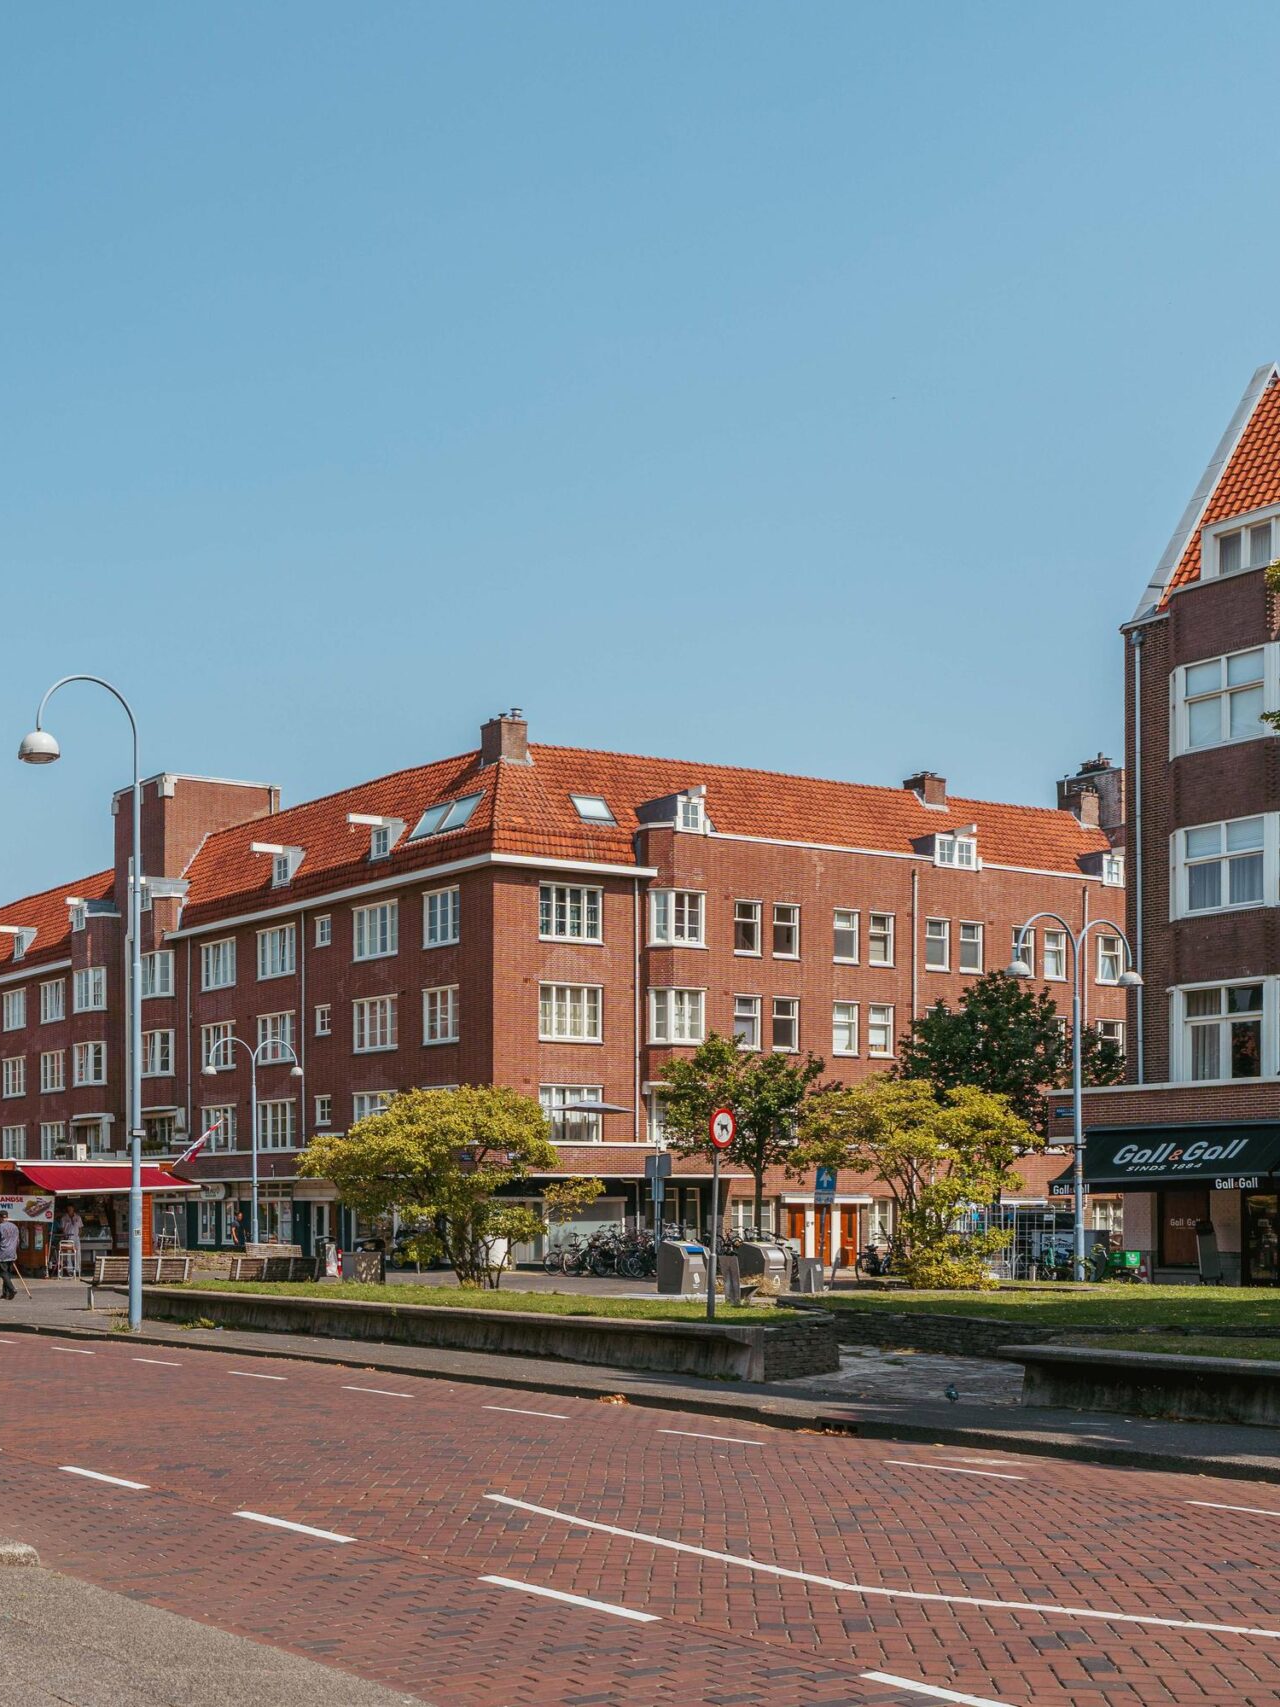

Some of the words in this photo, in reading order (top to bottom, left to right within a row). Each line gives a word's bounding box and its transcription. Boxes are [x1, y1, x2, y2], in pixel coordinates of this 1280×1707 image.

[1112, 1138, 1249, 1165] Gall&Gall
[1125, 1164, 1167, 1172] SINDS
[1171, 1162, 1202, 1170] 1884
[1170, 1218, 1184, 1226] Gall
[1187, 1218, 1200, 1226] Ga
